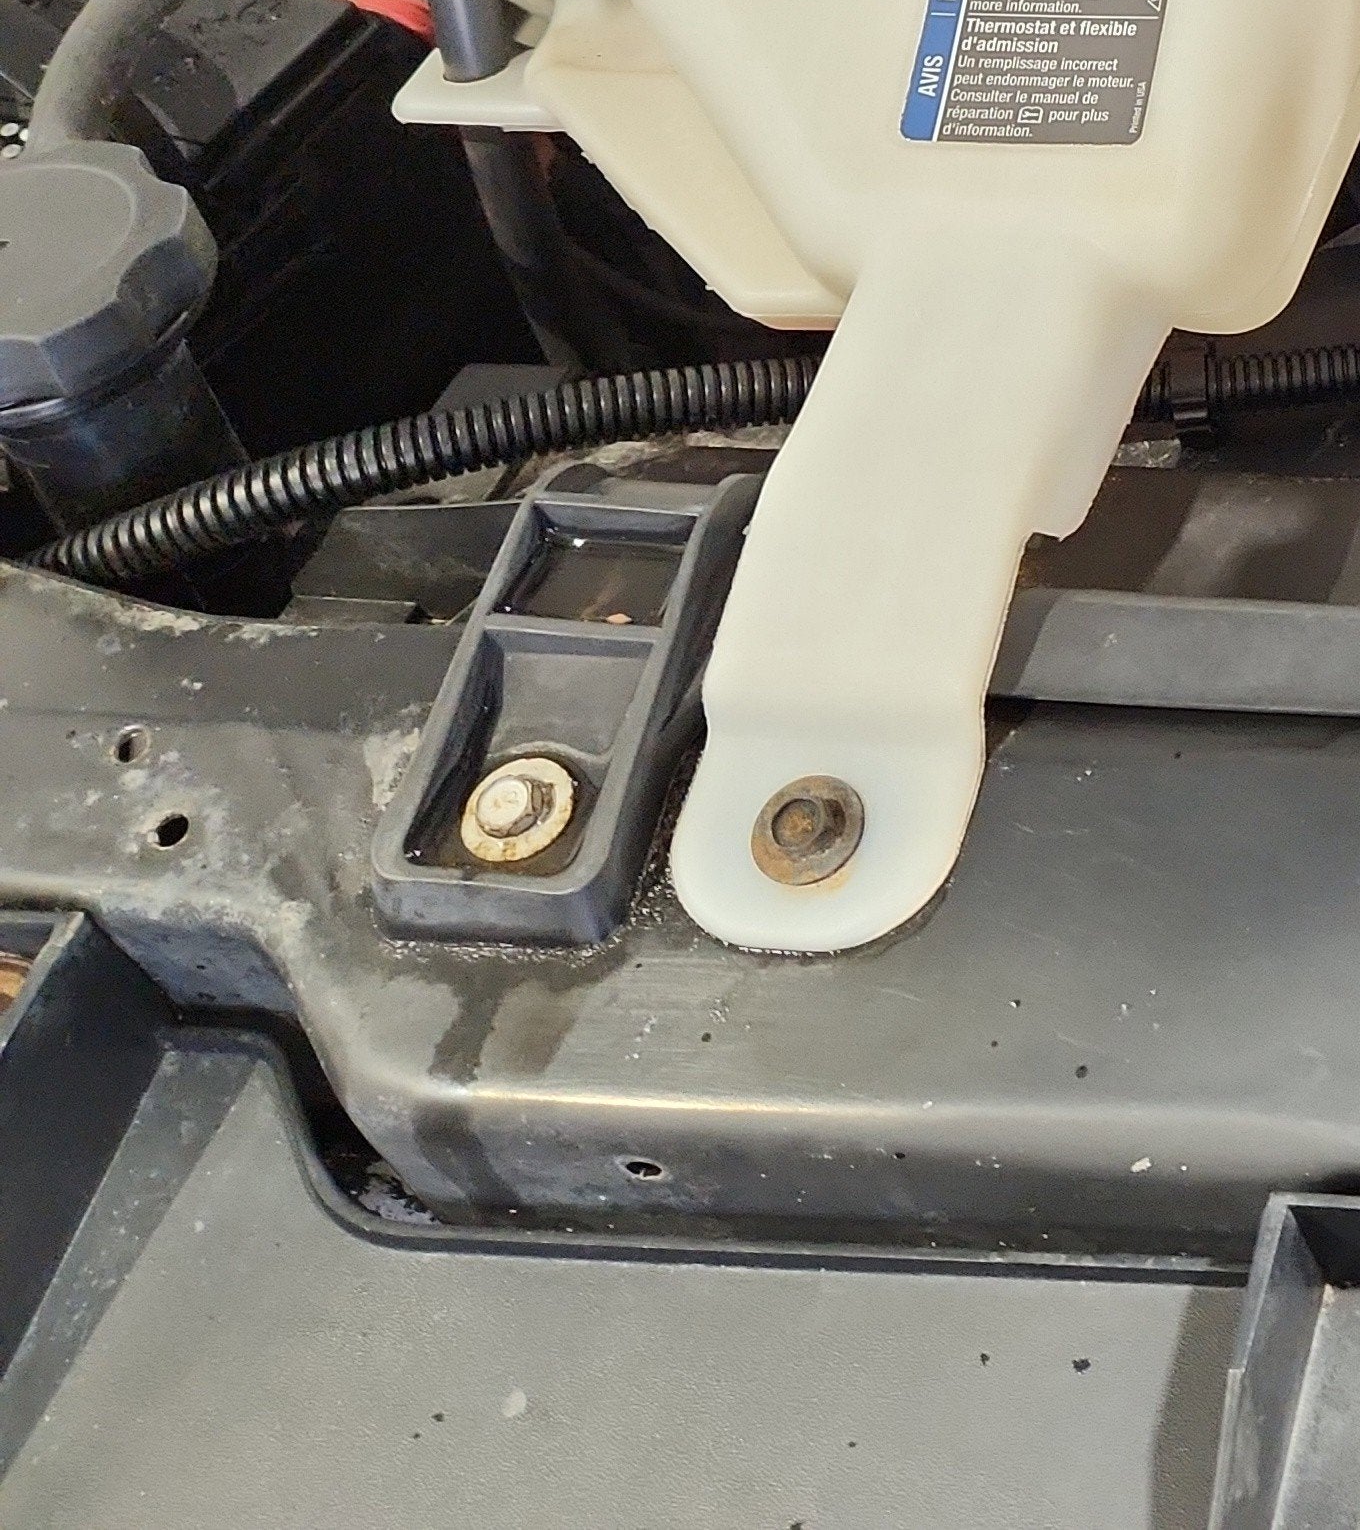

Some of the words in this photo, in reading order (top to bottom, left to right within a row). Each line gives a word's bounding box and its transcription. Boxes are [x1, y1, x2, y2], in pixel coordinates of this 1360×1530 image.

[970, 0, 1002, 11] more
[1006, 0, 1082, 13] information.
[966, 18, 1055, 34] Thermostat
[1060, 21, 1075, 35] et
[1079, 21, 1137, 36] flexible
[961, 37, 1058, 52] d'admission
[957, 55, 974, 67] Un
[979, 56, 1057, 72] remplissage
[1061, 58, 1118, 71] incorrect
[918, 55, 944, 97] AVIS
[953, 73, 982, 86] peut
[986, 74, 1070, 89] endommager
[1073, 75, 1085, 86] le
[1088, 76, 1134, 87] moteur.
[950, 89, 1012, 103] Consulter
[1017, 90, 1027, 103] le
[1031, 91, 1078, 104] manuel
[1083, 93, 1098, 104] de
[946, 107, 1013, 121] réparation
[1049, 111, 1078, 123] pour
[1082, 109, 1109, 123] plus
[943, 123, 1032, 137] d'information.
